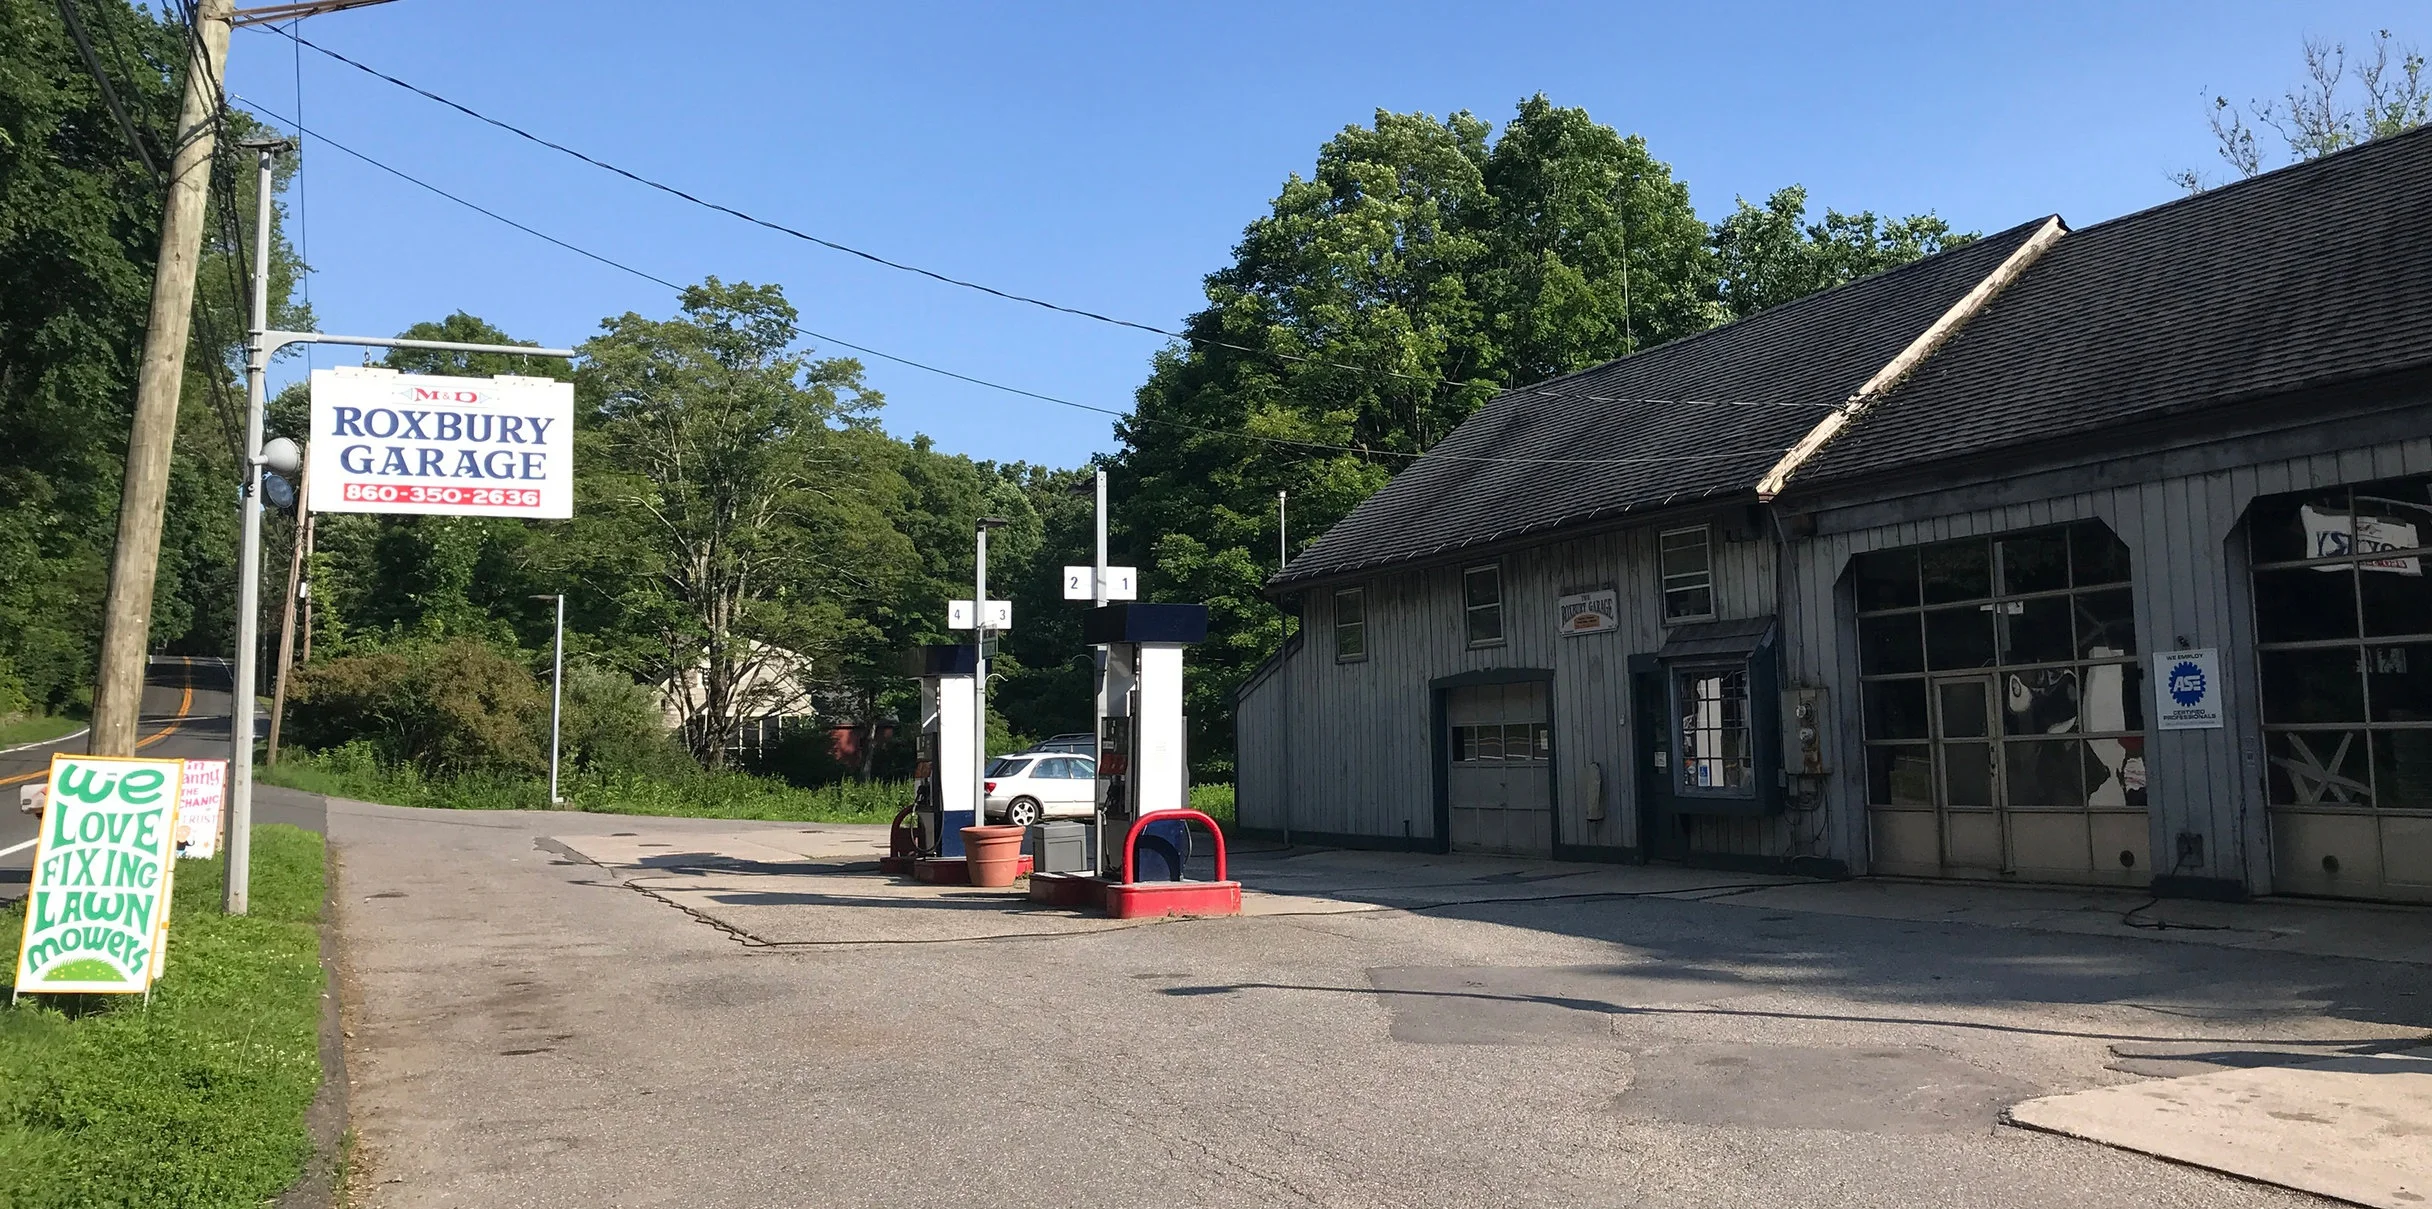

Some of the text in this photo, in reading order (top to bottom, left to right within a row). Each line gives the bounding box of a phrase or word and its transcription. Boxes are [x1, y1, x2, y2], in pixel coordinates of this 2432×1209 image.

[332, 406, 554, 445] ROXBURY
[340, 444, 547, 480] GARAGE
[346, 485, 539, 506] 860-350-2636
[1070, 576, 1078, 589] 2
[1122, 577, 1128, 590] 1
[954, 609, 961, 620] 4
[999, 609, 1006, 620] 3
[2173, 675, 2201, 692] ASE
[182, 769, 219, 785] anny
[51, 801, 163, 856] LOVE
[41, 848, 158, 888] FIXING
[33, 891, 154, 936] LAWN
